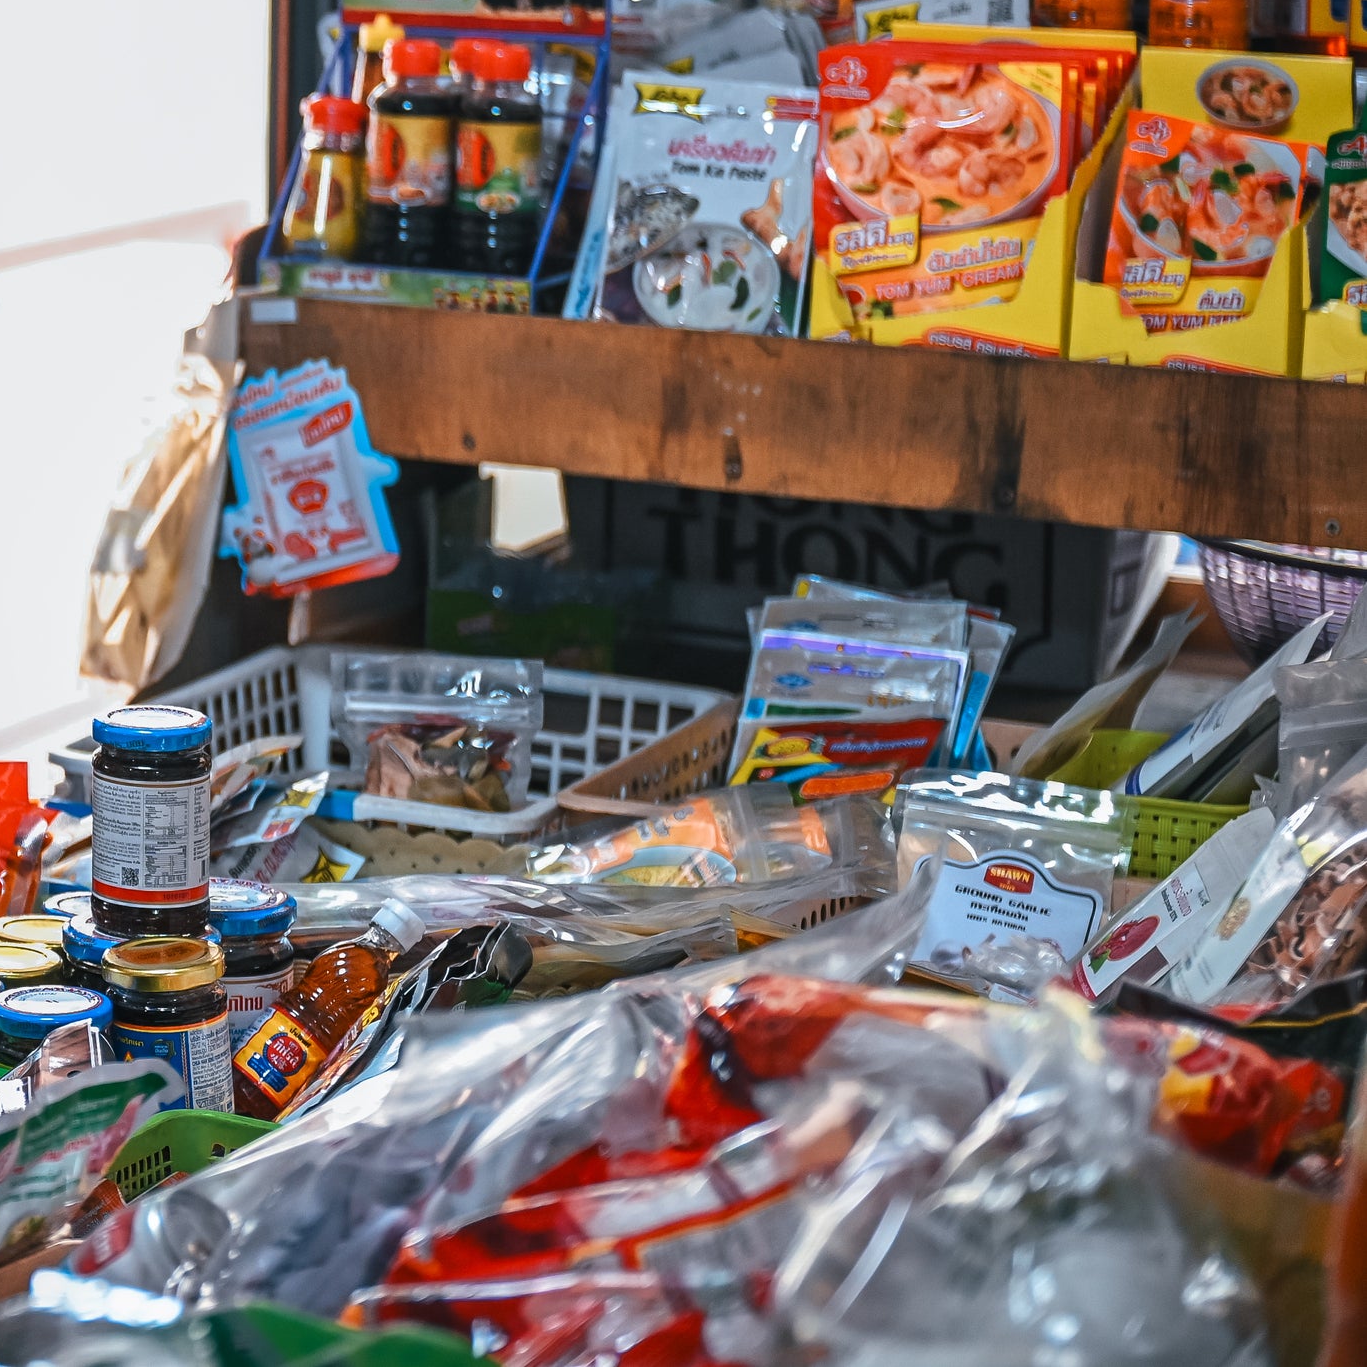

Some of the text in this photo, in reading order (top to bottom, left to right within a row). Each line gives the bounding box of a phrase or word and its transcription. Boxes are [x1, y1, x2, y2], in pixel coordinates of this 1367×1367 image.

[729, 166, 767, 181] Paste
[834, 220, 888, 254] รสดี
[875, 283, 909, 300] TOM
[914, 277, 952, 295] YUM
[1197, 288, 1246, 311] ต้มยำ
[1172, 314, 1203, 329] YUM
[647, 507, 1008, 609] THONG
[990, 866, 1031, 884] SHAWN
[954, 884, 1053, 917] GROUND GARLIC
[991, 919, 1027, 932] NATURAL
[272, 1038, 301, 1068] ทิพรส
